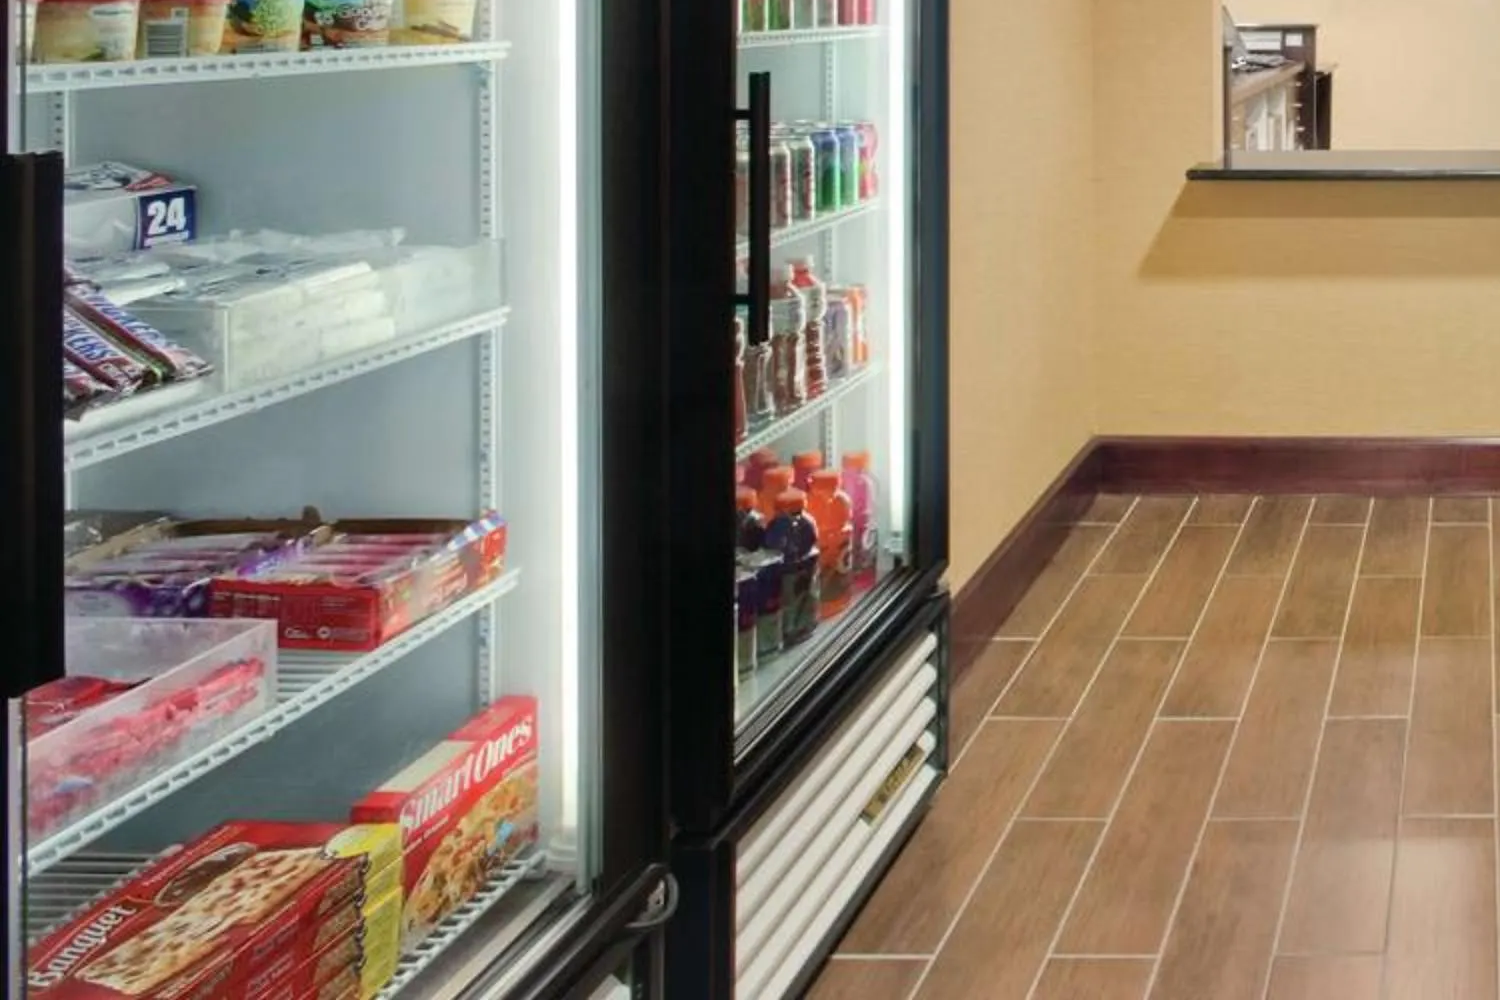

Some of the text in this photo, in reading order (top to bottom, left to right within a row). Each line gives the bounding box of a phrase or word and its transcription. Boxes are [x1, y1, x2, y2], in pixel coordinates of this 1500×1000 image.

[146, 197, 187, 236] 24
[400, 714, 533, 829] Smart Ones
[27, 902, 138, 988] Banquet
